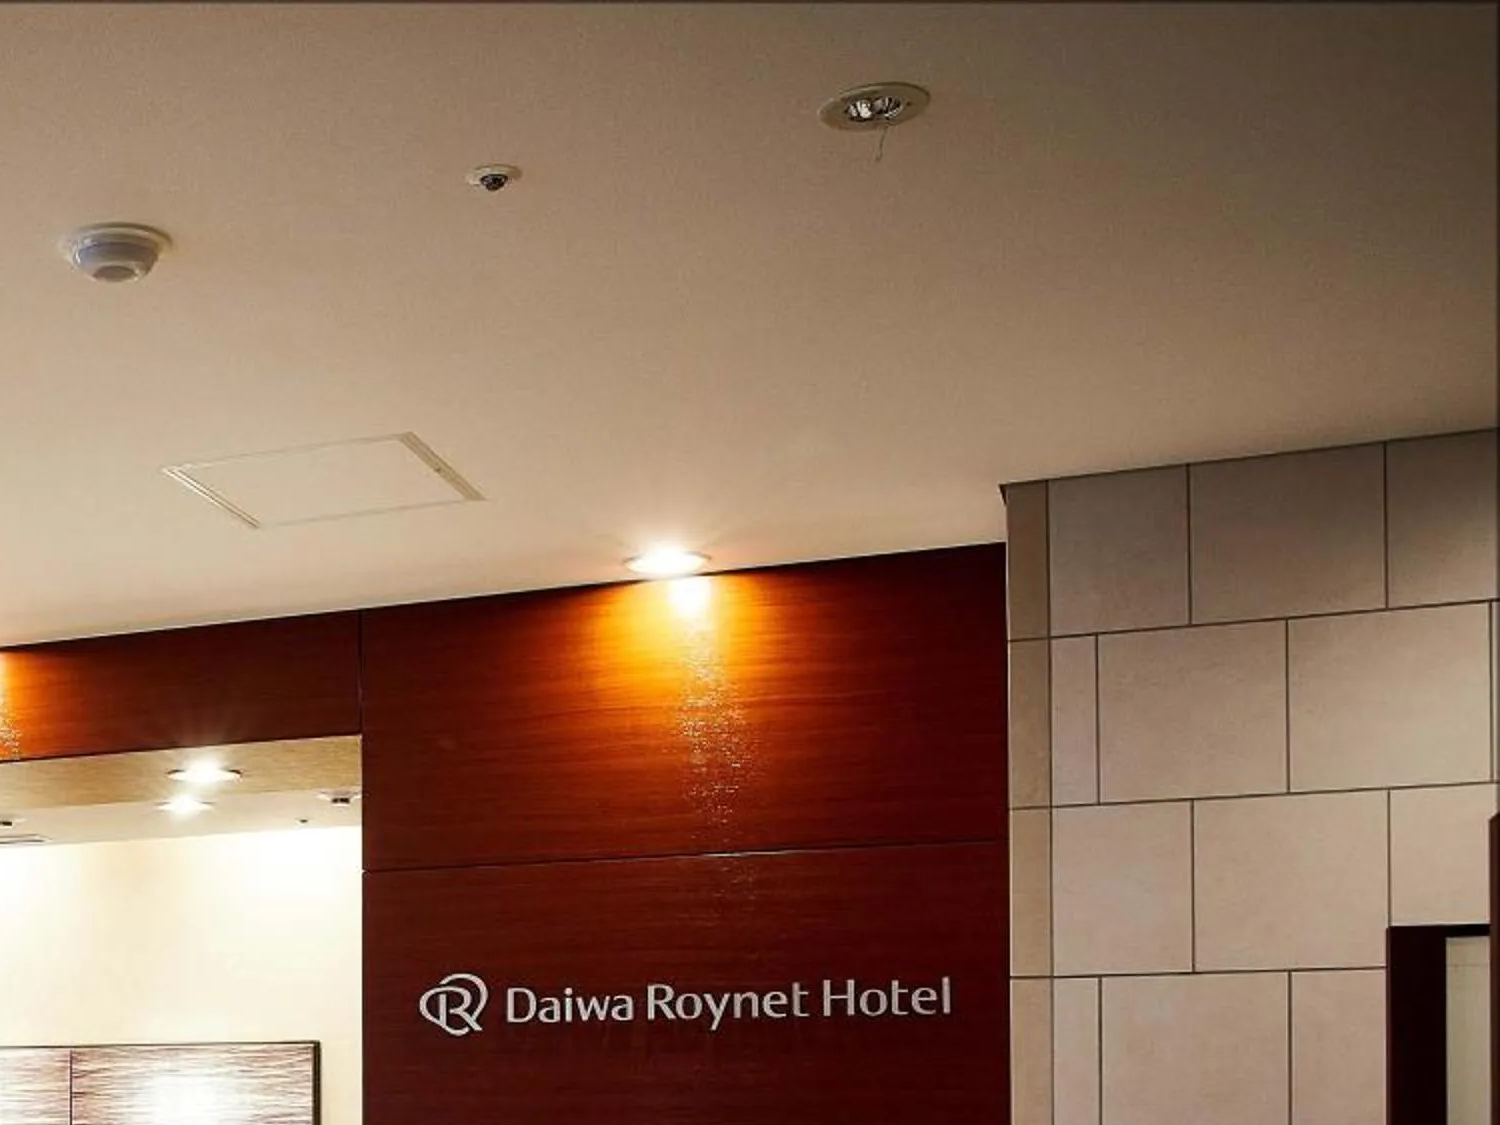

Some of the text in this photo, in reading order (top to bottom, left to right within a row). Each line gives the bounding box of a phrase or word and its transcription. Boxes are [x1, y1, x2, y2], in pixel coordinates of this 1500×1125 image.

[506, 987, 634, 1024] Daiwa
[647, 981, 810, 1032] Roynet
[823, 976, 952, 1017] Hotel
